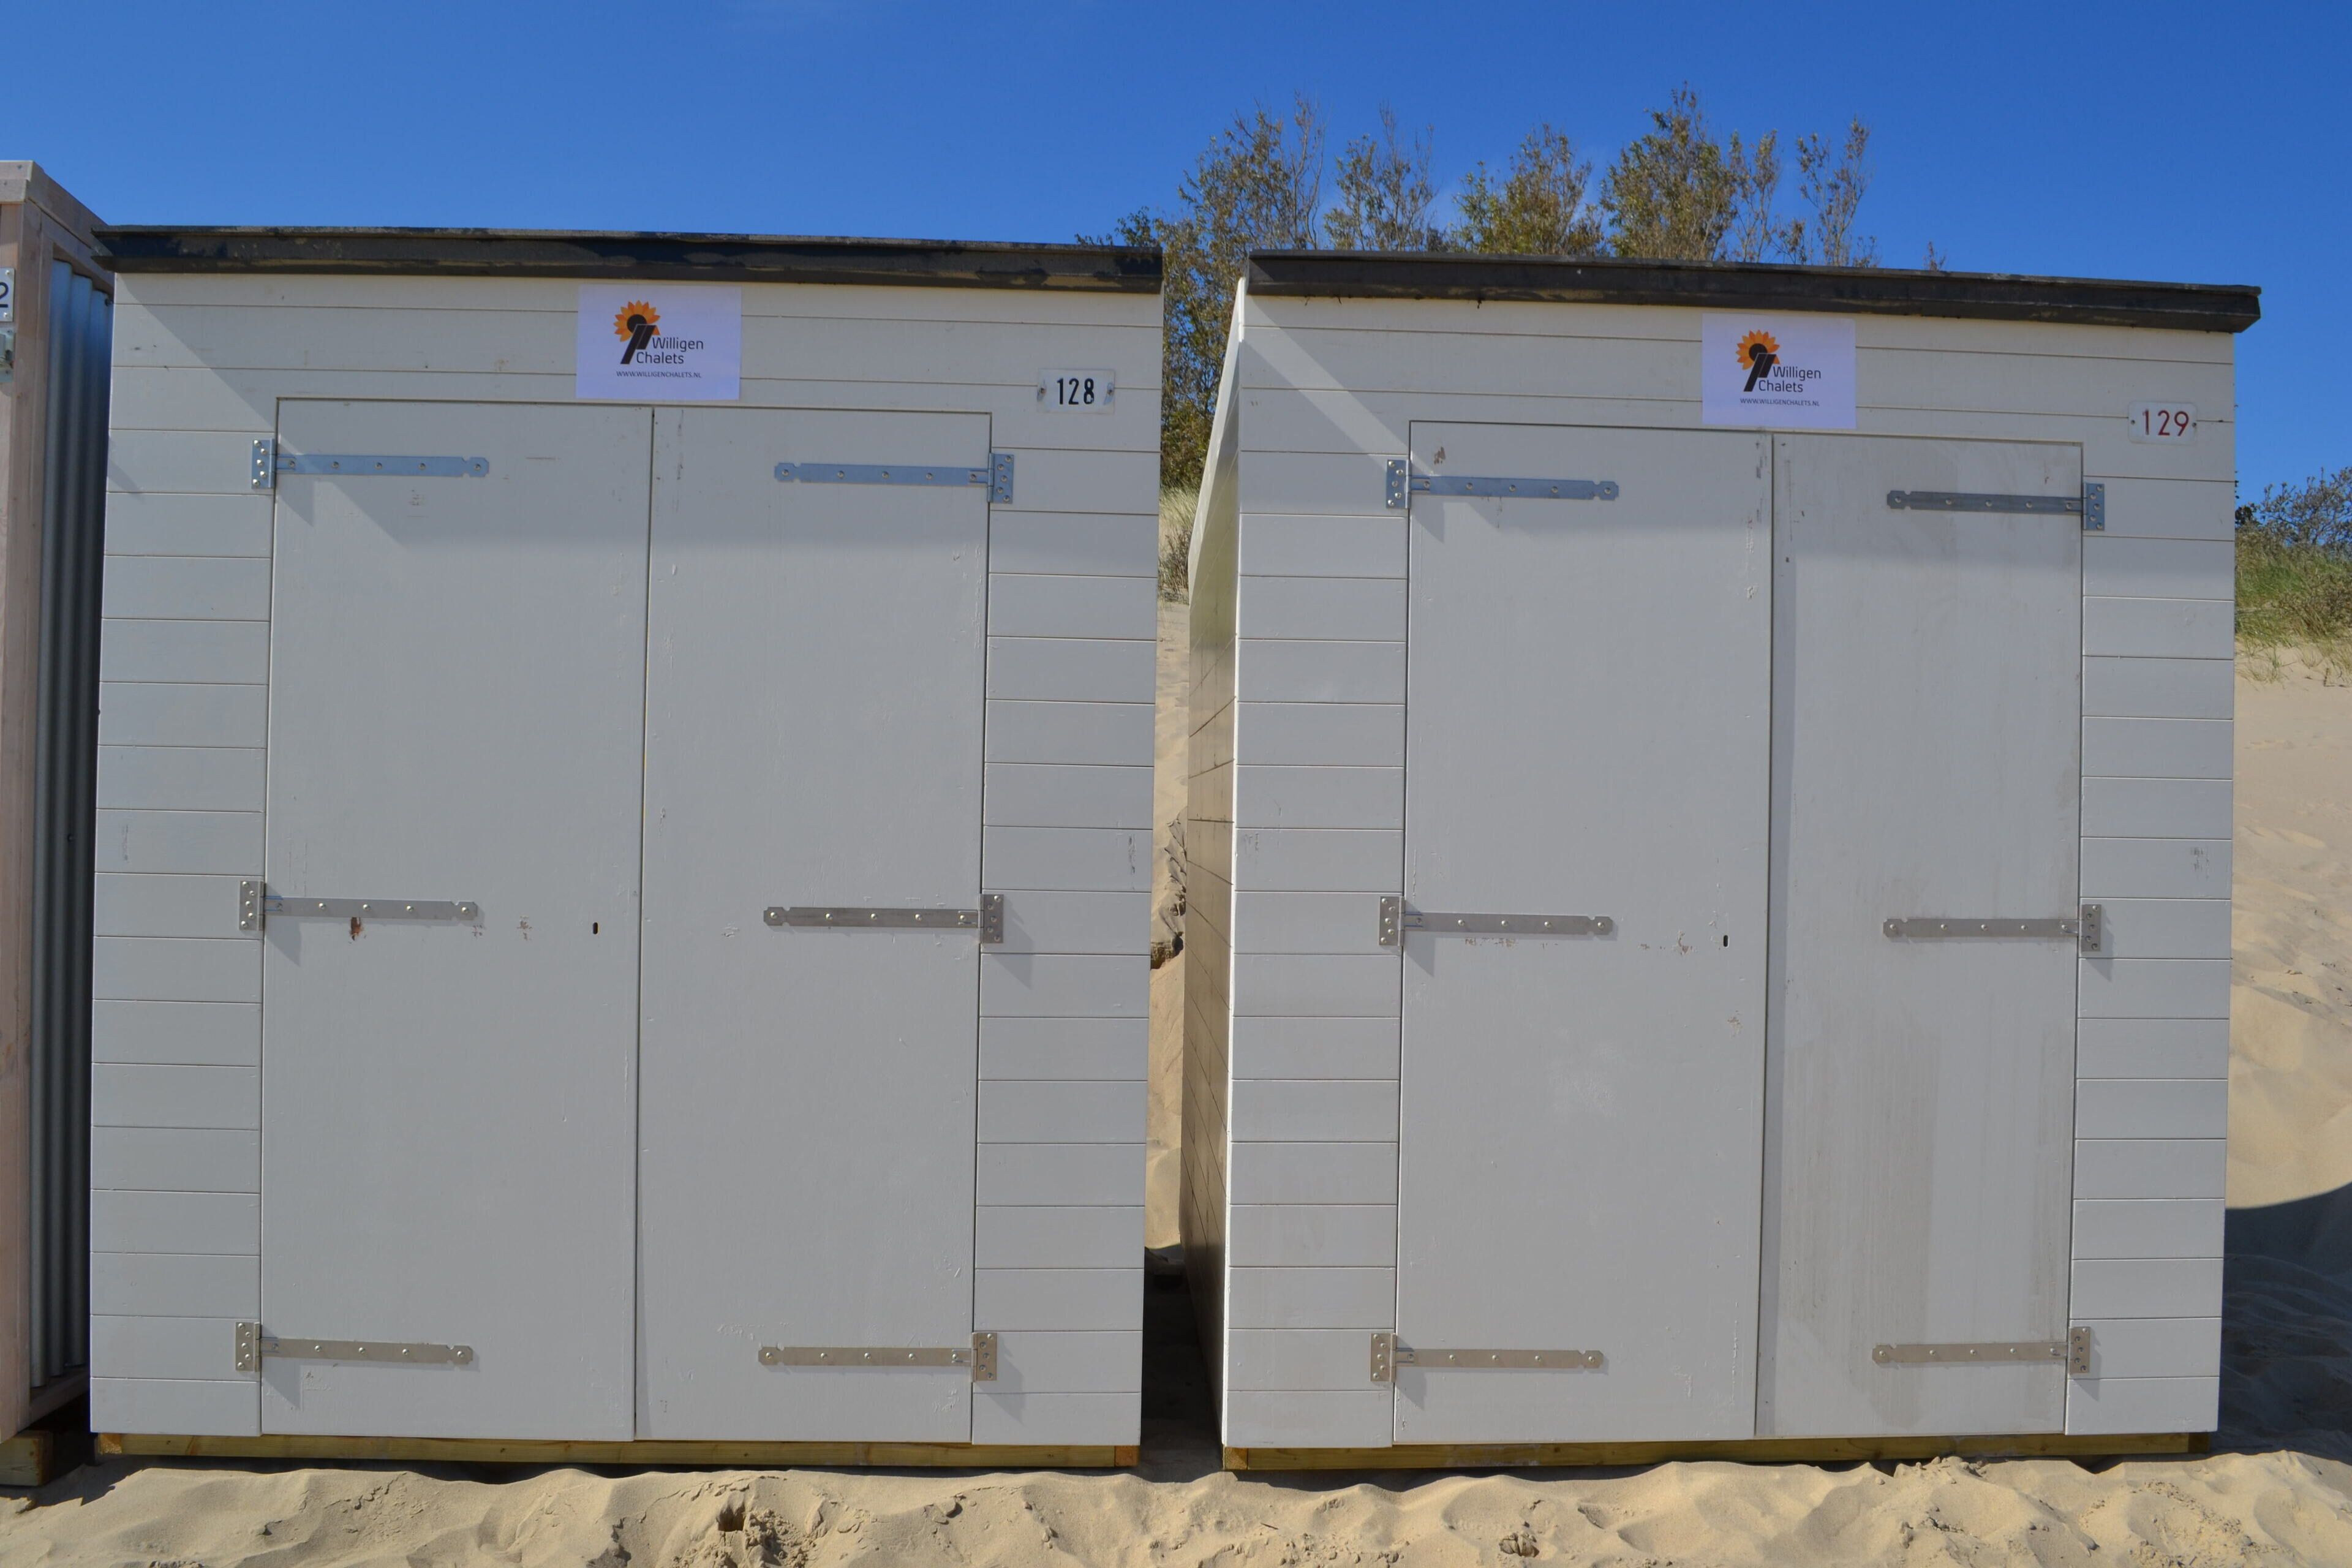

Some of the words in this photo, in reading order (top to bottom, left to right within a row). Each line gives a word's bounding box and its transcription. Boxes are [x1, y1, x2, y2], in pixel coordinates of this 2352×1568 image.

[652, 336, 704, 352] Willigen
[636, 352, 684, 364] Chalets
[1773, 366, 1822, 381] Willigen
[1057, 378, 1095, 405] 128
[1758, 380, 1803, 393] Chalets
[2142, 409, 2189, 437] 129
